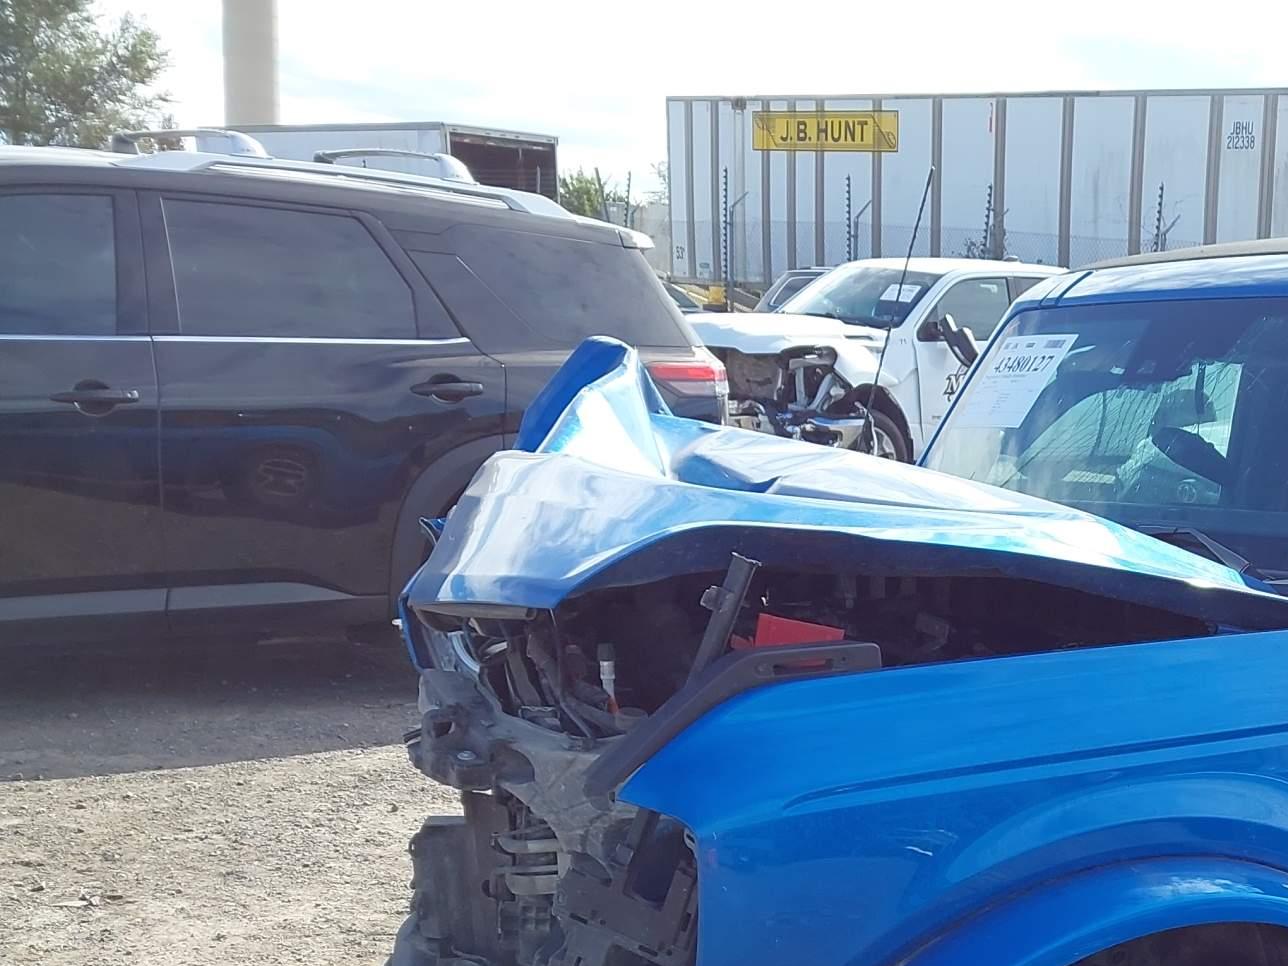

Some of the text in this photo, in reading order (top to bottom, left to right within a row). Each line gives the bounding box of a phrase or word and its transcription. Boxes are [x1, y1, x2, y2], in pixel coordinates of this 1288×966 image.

[816, 119, 869, 143] HUNT
[1230, 121, 1254, 135] JBHU
[1226, 135, 1255, 150] 212338
[994, 355, 1055, 373] 43480127
